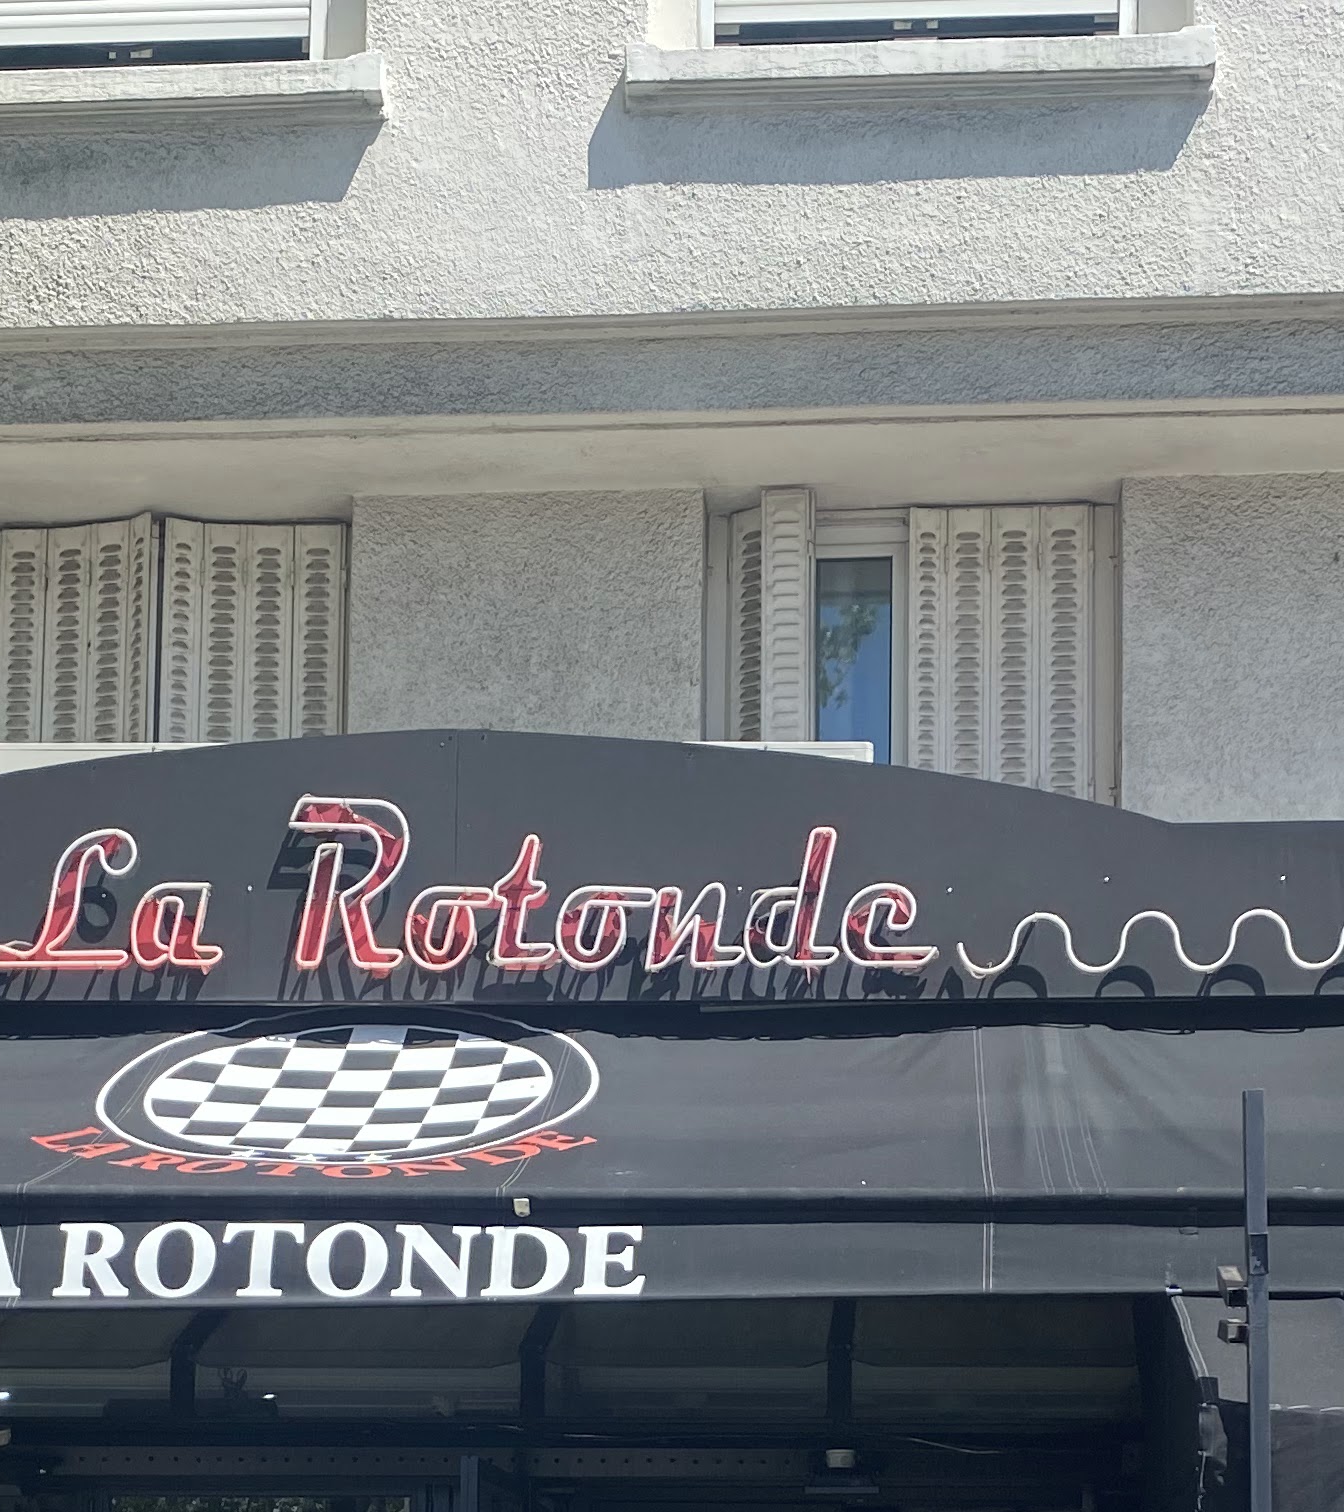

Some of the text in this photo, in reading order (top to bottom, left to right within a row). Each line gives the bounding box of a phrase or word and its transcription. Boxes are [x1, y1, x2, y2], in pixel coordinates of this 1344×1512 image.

[287, 795, 938, 978] Rotonde
[30, 1125, 598, 1179] LA ROTONDE
[52, 1222, 648, 1299] ROTONDE
